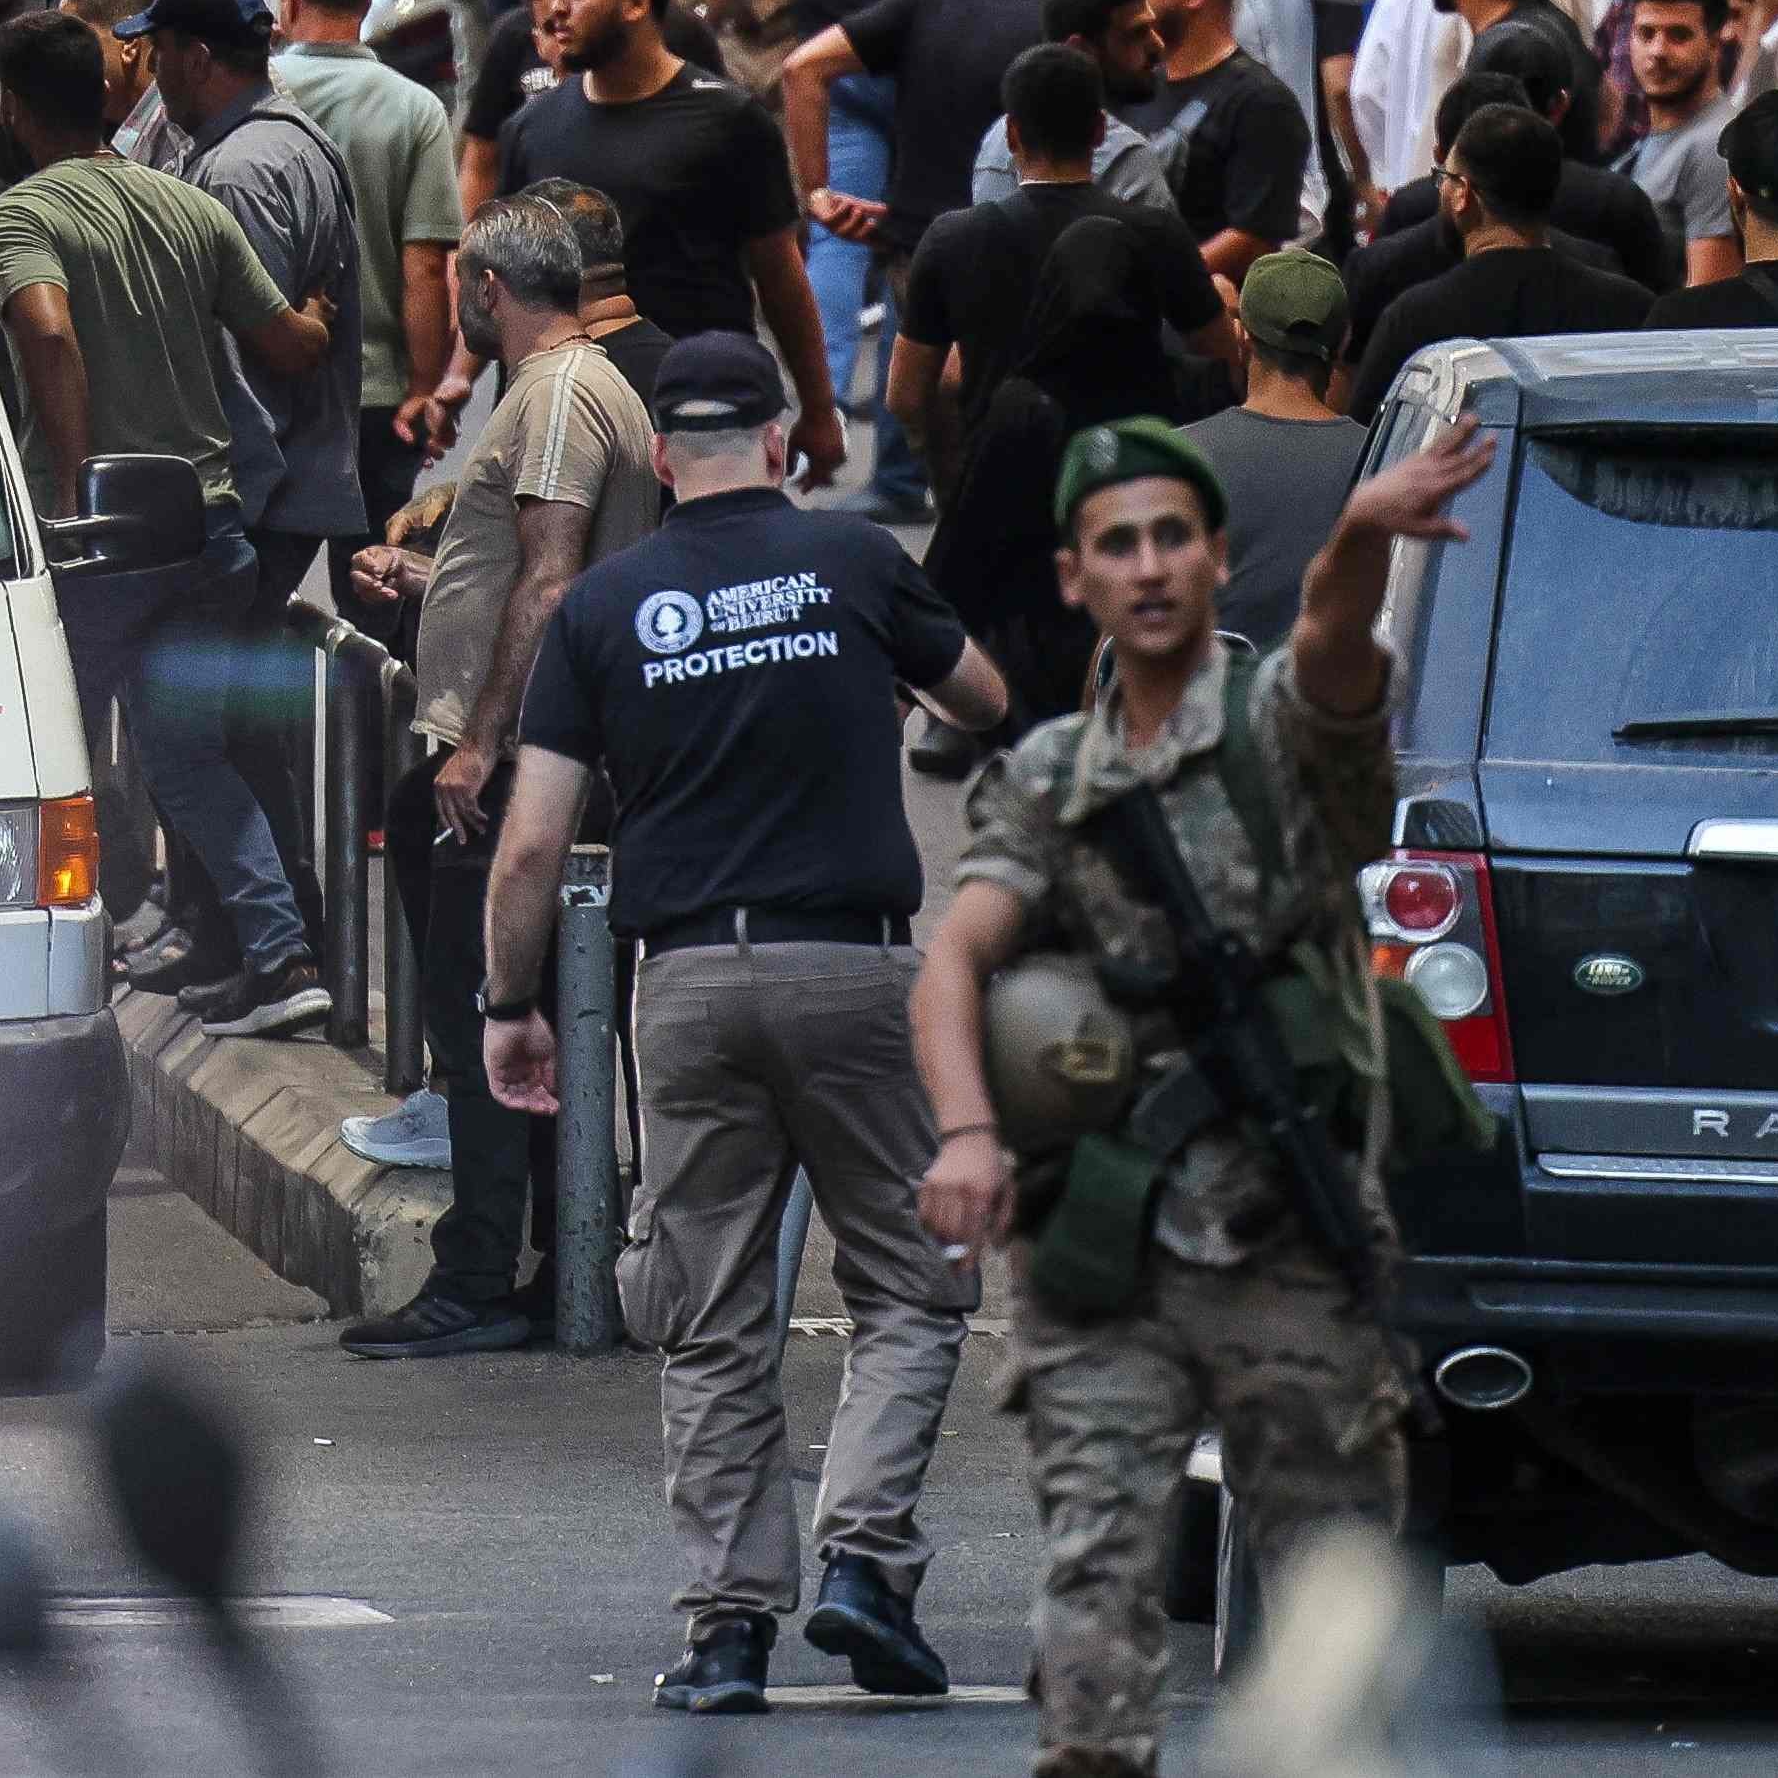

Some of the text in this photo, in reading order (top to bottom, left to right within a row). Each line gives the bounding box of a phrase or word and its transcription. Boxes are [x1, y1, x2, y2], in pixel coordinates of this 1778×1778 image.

[705, 587, 834, 622] UNIVERSITY
[706, 572, 818, 604] AMERICAN
[726, 604, 804, 633] BEIRUT
[641, 630, 840, 689] PROTECTION
